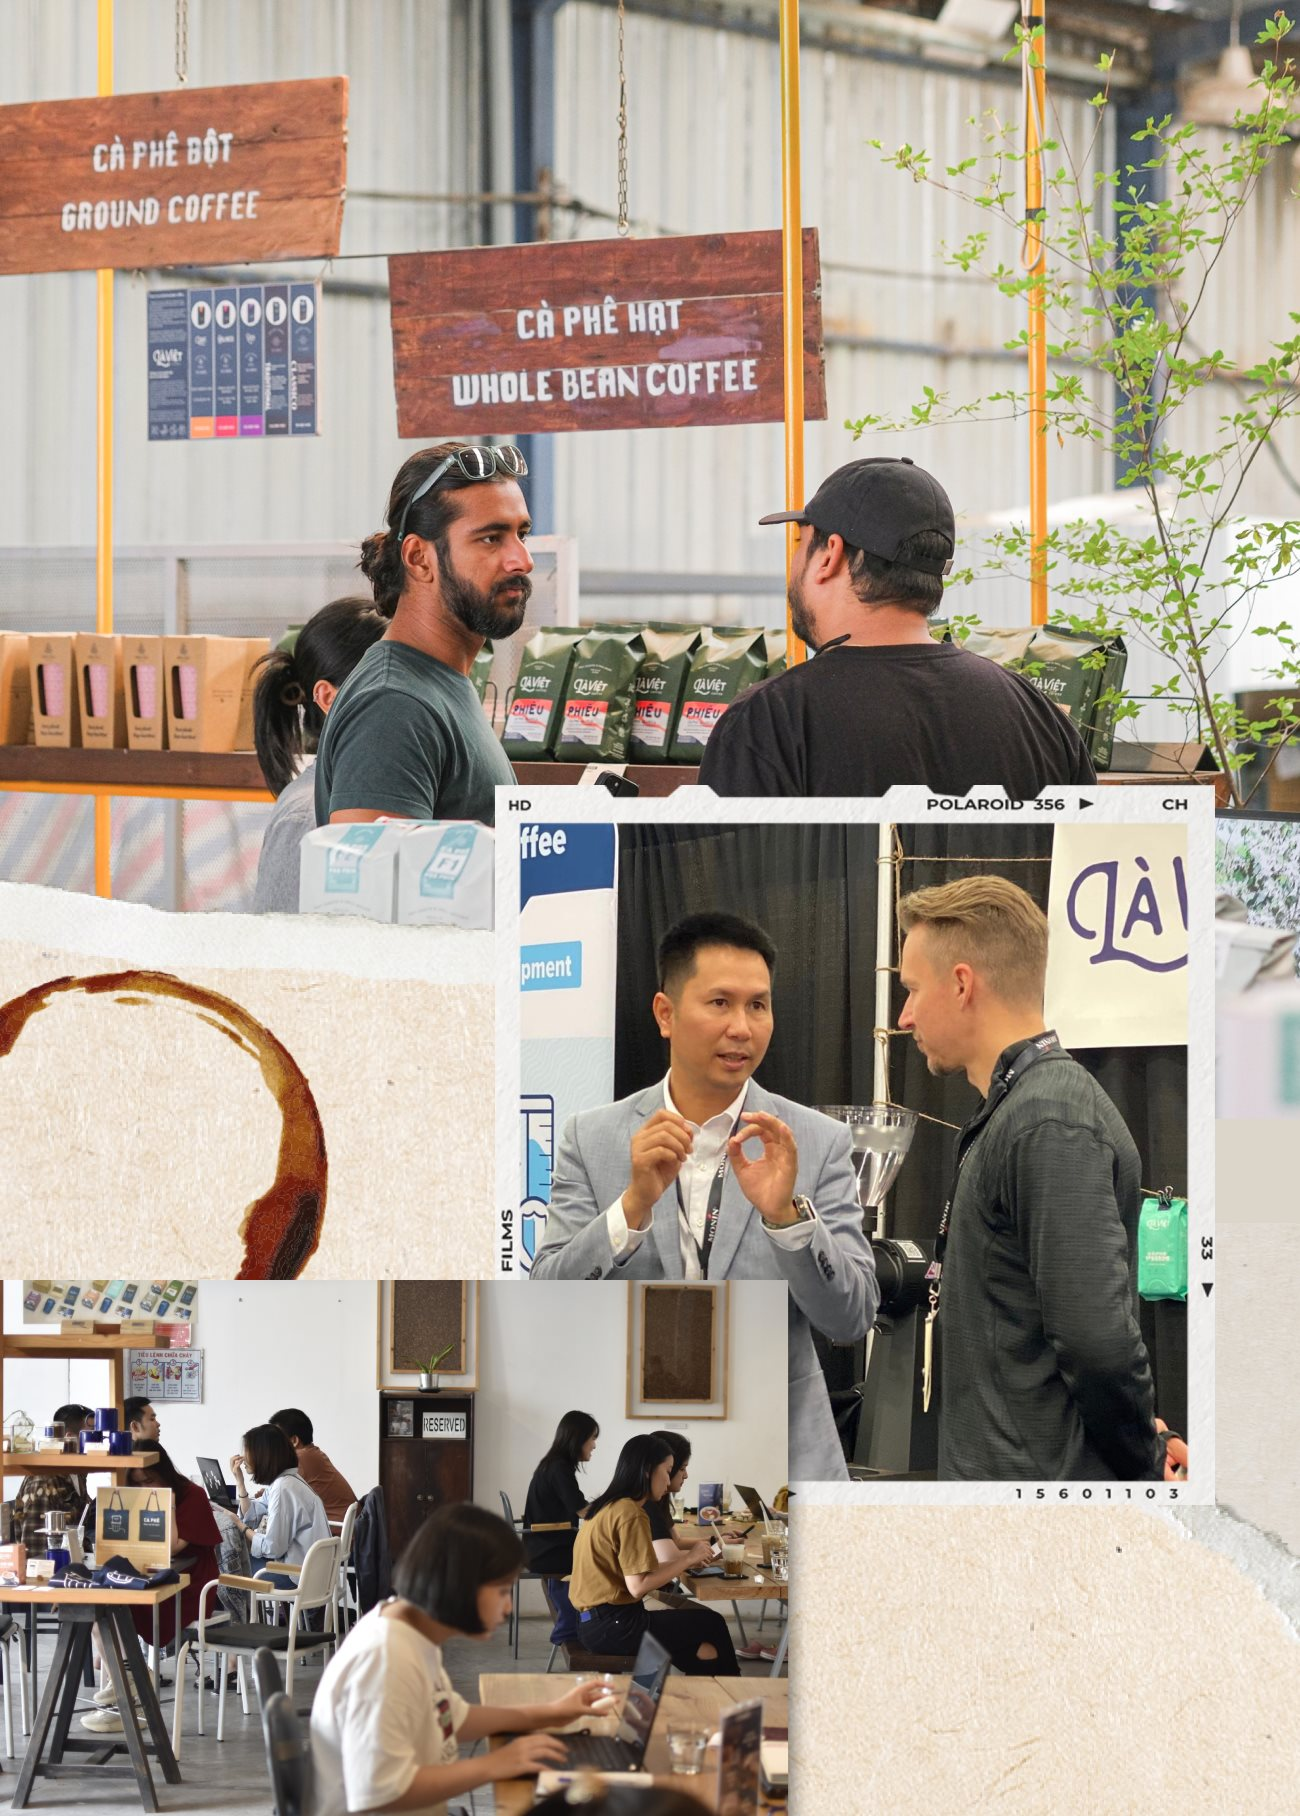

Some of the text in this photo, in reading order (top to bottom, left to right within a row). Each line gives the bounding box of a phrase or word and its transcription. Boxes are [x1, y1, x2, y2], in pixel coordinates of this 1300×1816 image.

[93, 127, 234, 173] CÀ PHÊ BỘT
[61, 191, 260, 232] GROUND COFFEE
[516, 296, 683, 340] CÀ PHÊ HẠT
[452, 359, 758, 407] WHOLE BEAN COFFEE
[635, 704, 662, 718] HIÊU
[520, 825, 567, 859] ffee
[521, 955, 572, 986] pment
[708, 1207, 719, 1242] MONIN
[424, 1418, 465, 1431] RESERVED
